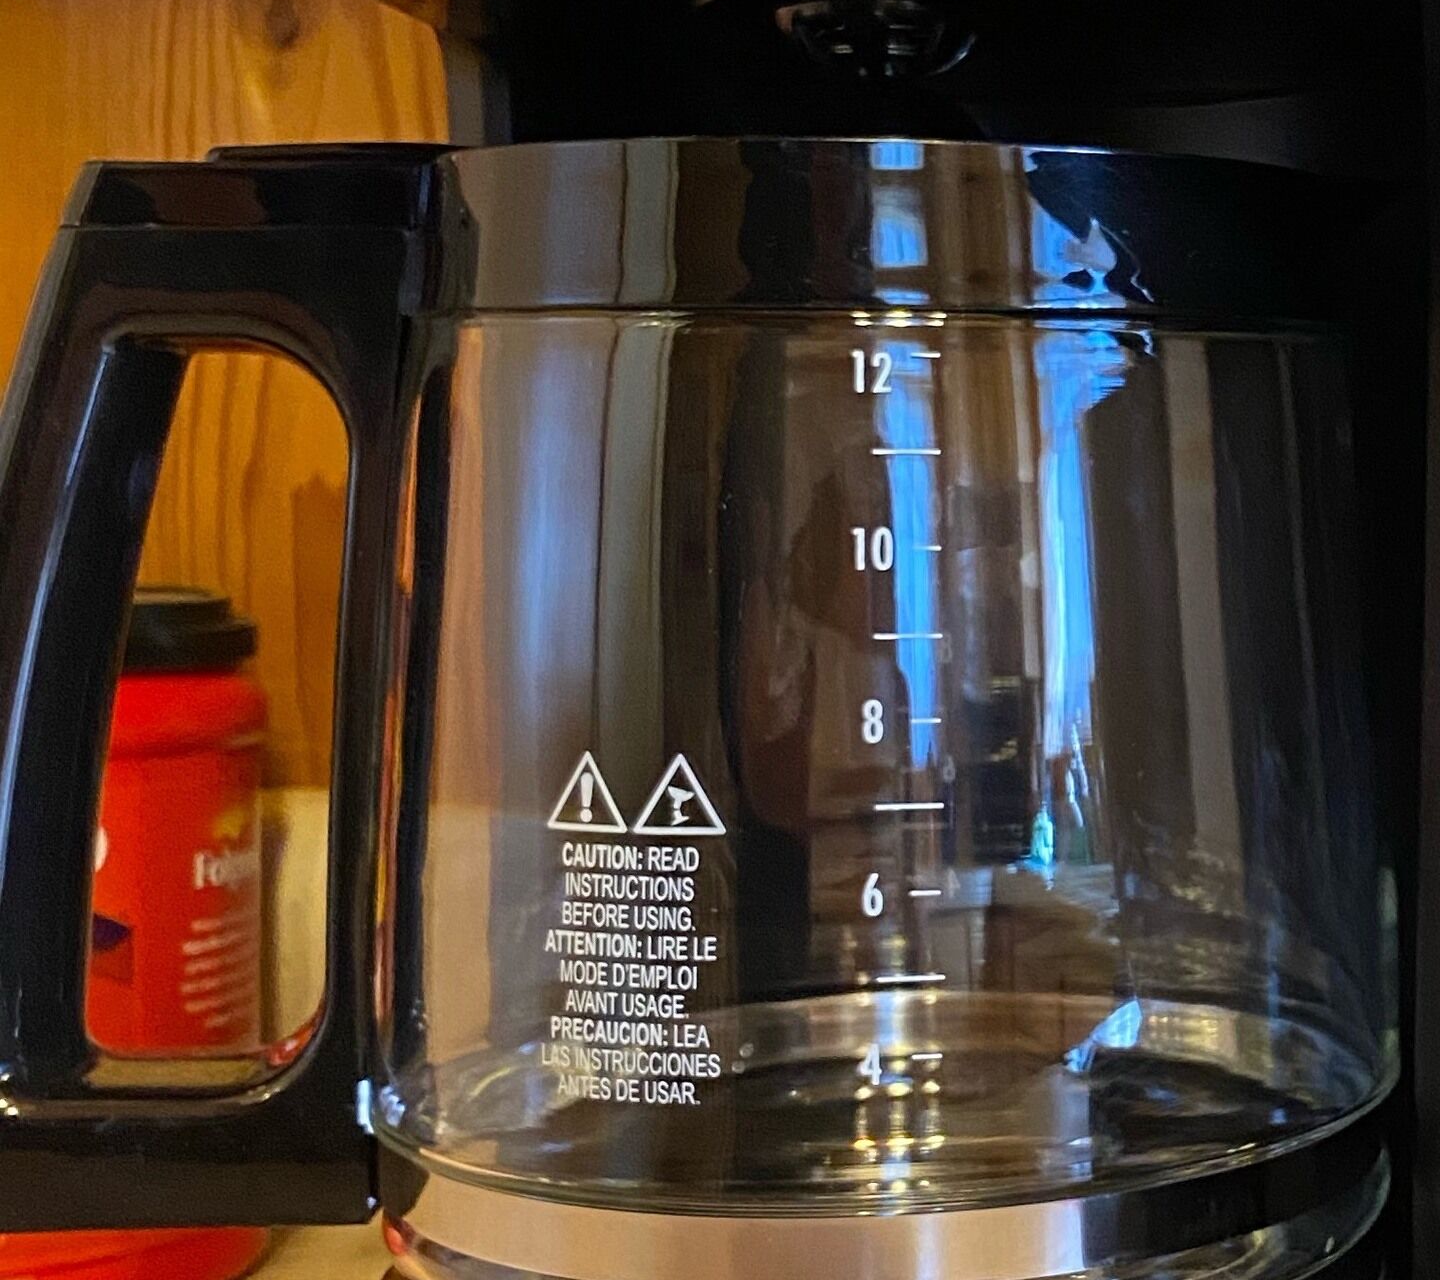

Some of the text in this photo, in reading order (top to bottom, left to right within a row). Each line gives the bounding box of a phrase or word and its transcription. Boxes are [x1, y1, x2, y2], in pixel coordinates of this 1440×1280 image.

[851, 349, 893, 395] 12
[851, 526, 895, 572] 10
[861, 698, 885, 745] 8
[561, 841, 700, 873] CAUTION: READ
[564, 871, 695, 902] INSTRUCTIONS
[861, 872, 885, 919] 6
[561, 901, 696, 932] BEFORE USING.
[544, 928, 718, 962] ATTENTION: LIRE LE
[559, 959, 698, 990] MODE D'EMPLOI
[565, 988, 690, 1019] AVANT USAGE.
[550, 1015, 710, 1049] PRECAUCION: LEA
[541, 1042, 721, 1078] LAS INSTRUCCIONES
[857, 1042, 882, 1086] 4
[557, 1073, 701, 1105] ANTES DE USAR.
